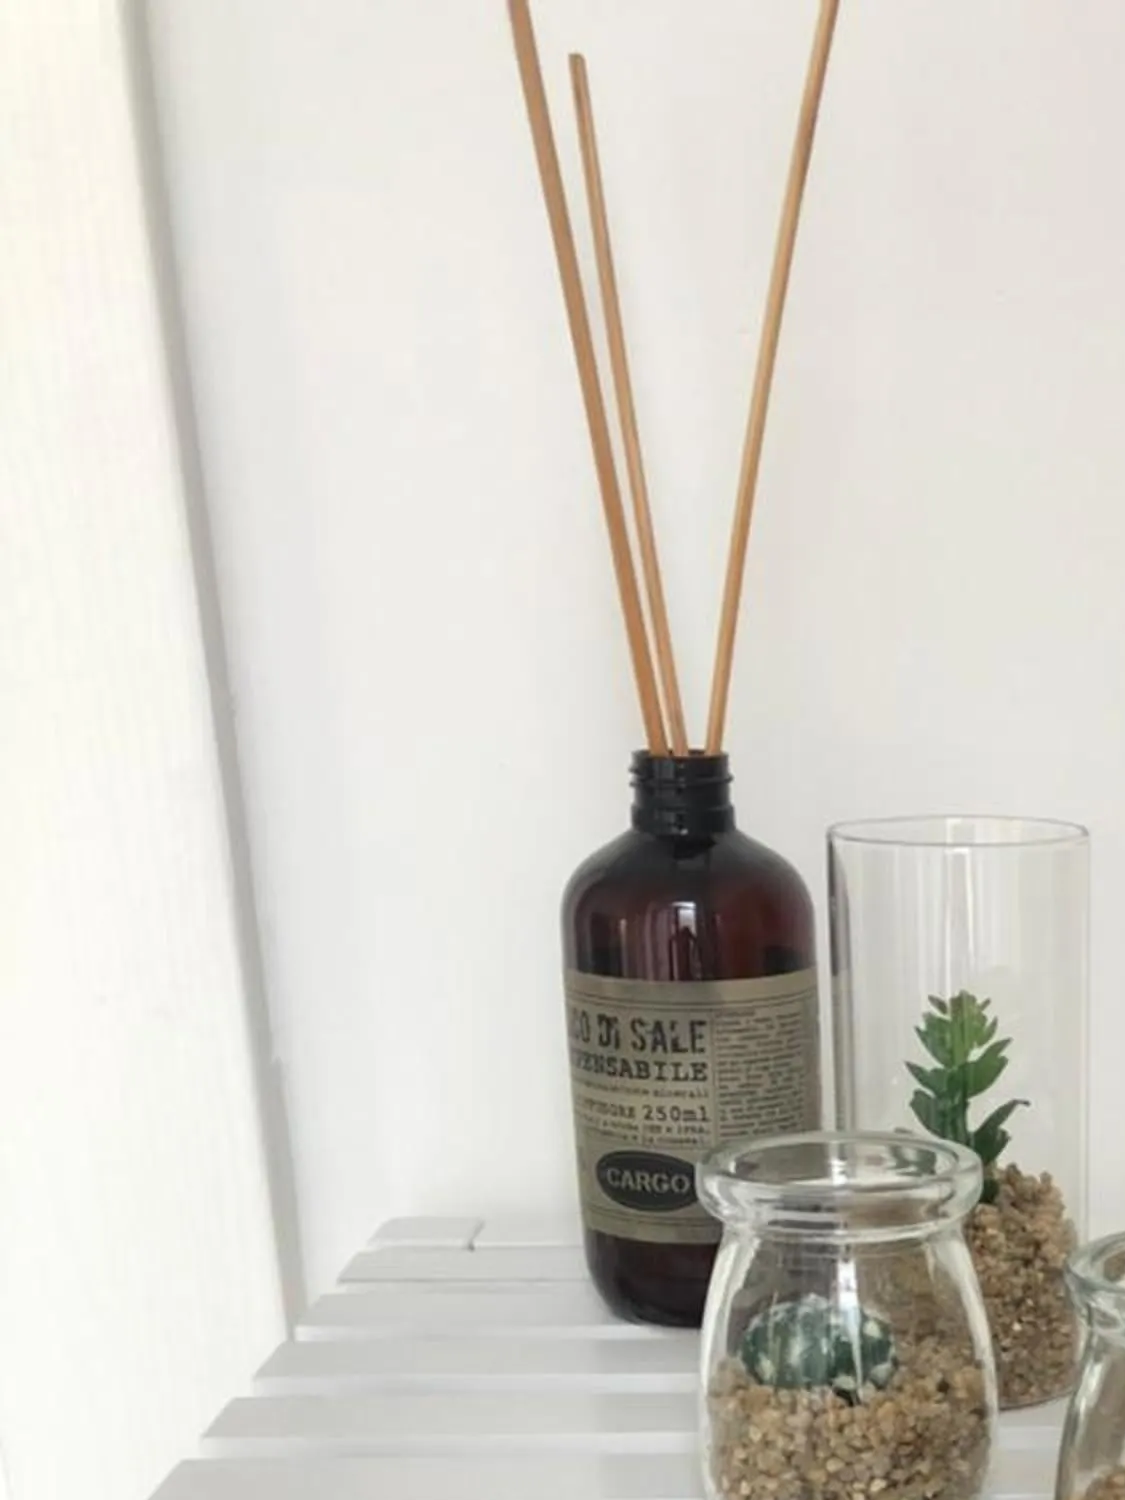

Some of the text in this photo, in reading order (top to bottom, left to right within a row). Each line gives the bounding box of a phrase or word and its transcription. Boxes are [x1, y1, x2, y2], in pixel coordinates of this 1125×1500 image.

[629, 1016, 708, 1054] SALE
[641, 1104, 711, 1122] 250ml
[605, 1166, 691, 1194] CARGO
